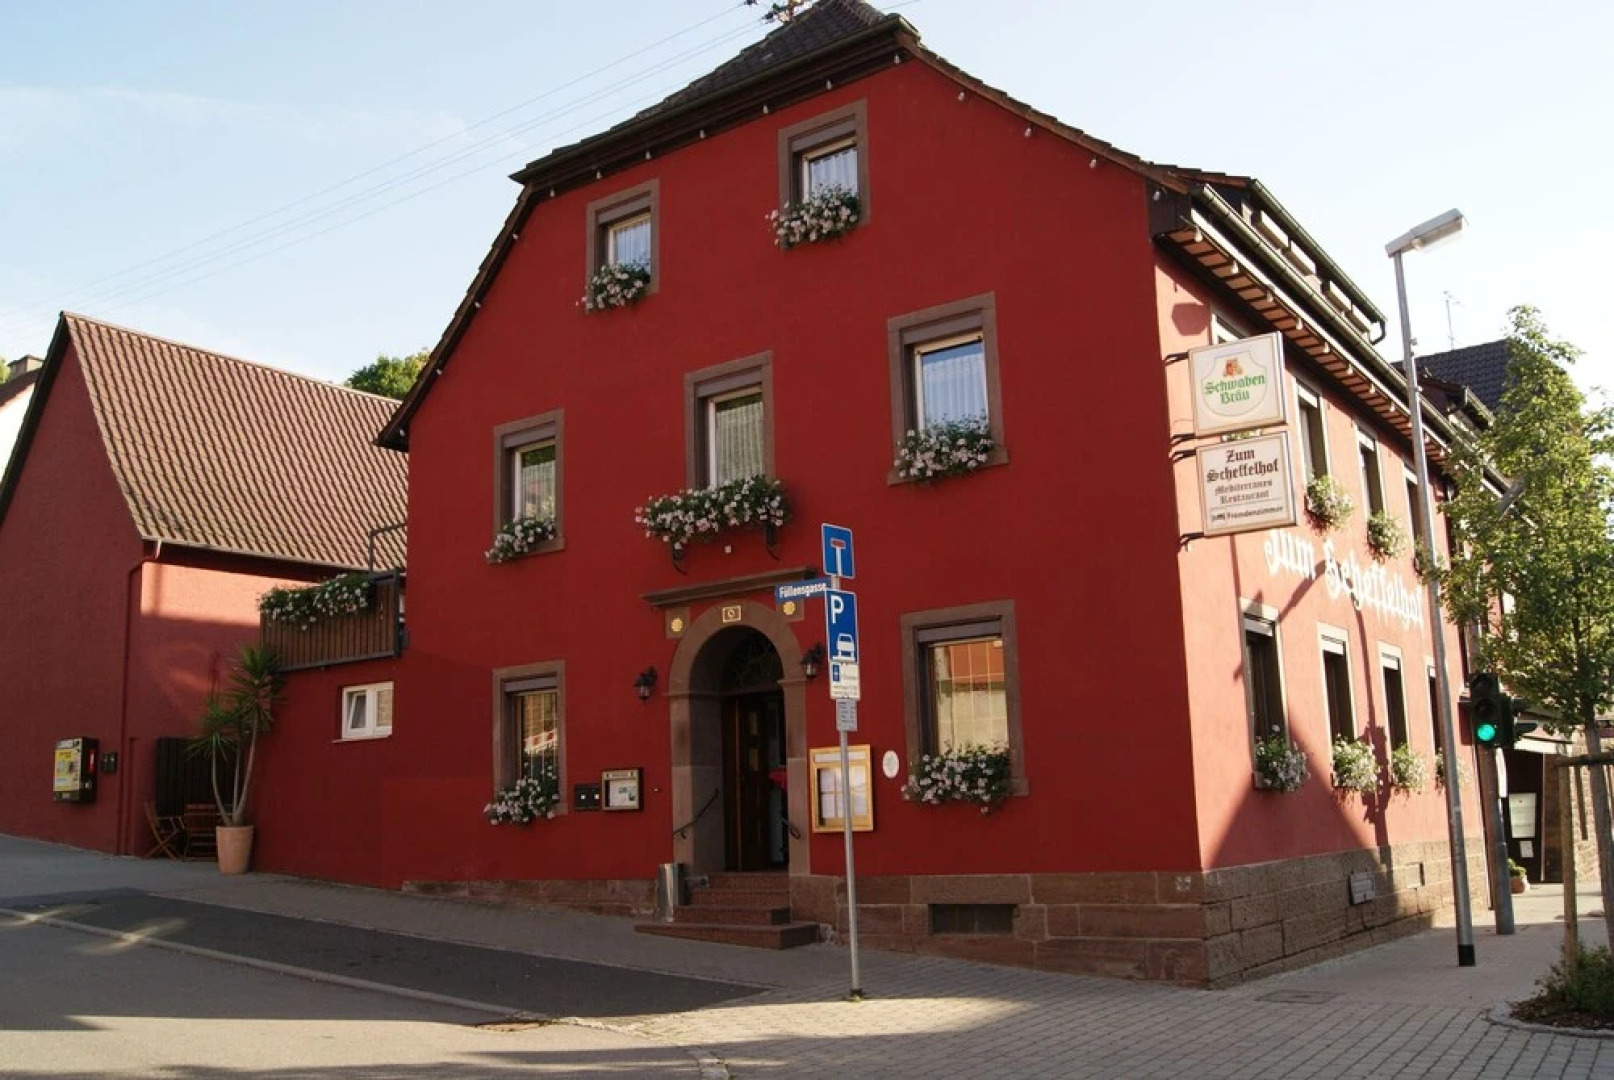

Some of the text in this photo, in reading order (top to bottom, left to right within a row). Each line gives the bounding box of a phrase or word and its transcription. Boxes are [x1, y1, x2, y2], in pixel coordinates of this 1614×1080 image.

[1205, 374, 1265, 394] Schwaben
[1220, 390, 1250, 404] Bräu
[1226, 449, 1255, 463] Zum
[1206, 458, 1279, 483] Scheffelhof
[1220, 490, 1269, 504] Restaurant
[779, 582, 828, 599] Füllensgasse
[830, 595, 845, 624] P
